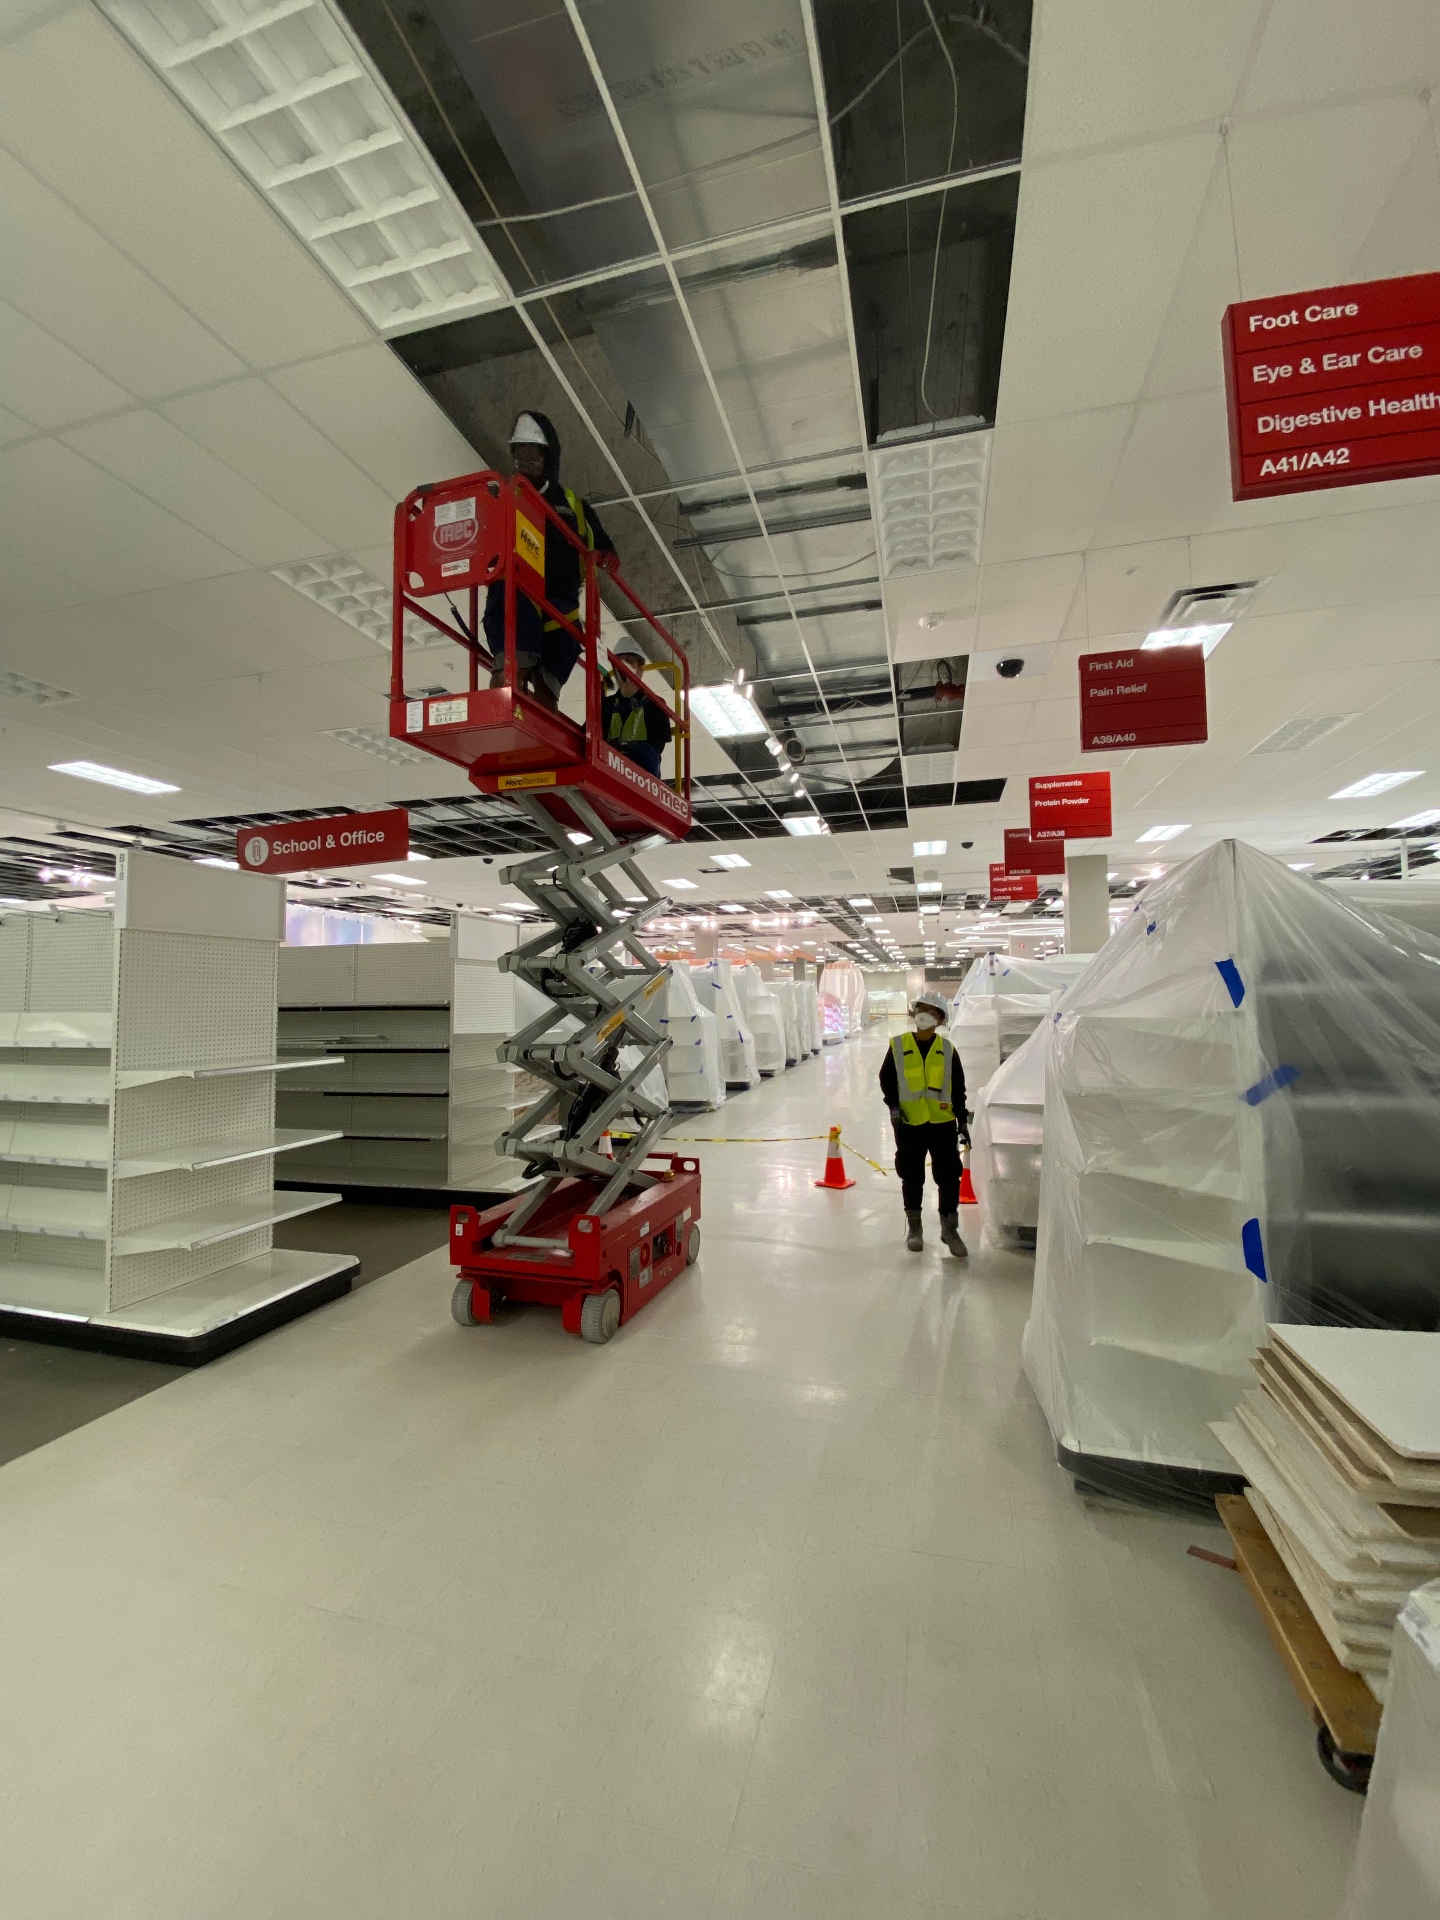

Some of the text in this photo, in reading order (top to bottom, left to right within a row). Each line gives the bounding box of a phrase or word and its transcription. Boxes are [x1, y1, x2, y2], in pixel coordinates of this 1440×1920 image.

[1249, 302, 1359, 332] Foot Care
[1252, 344, 1423, 384] Eye & Ear Care
[1257, 391, 1440, 434] Digestive Health
[1259, 447, 1350, 476] A41/A42
[1089, 658, 1134, 671] First Aid
[1089, 682, 1148, 698] Pain Relief
[1091, 733, 1137, 745] A39/A40
[607, 750, 659, 797] Micro19
[1034, 780, 1083, 790] Supplements
[1034, 797, 1090, 807] Protein Powder
[272, 829, 385, 855] School & Office
[1036, 830, 1065, 838] A37/A38
